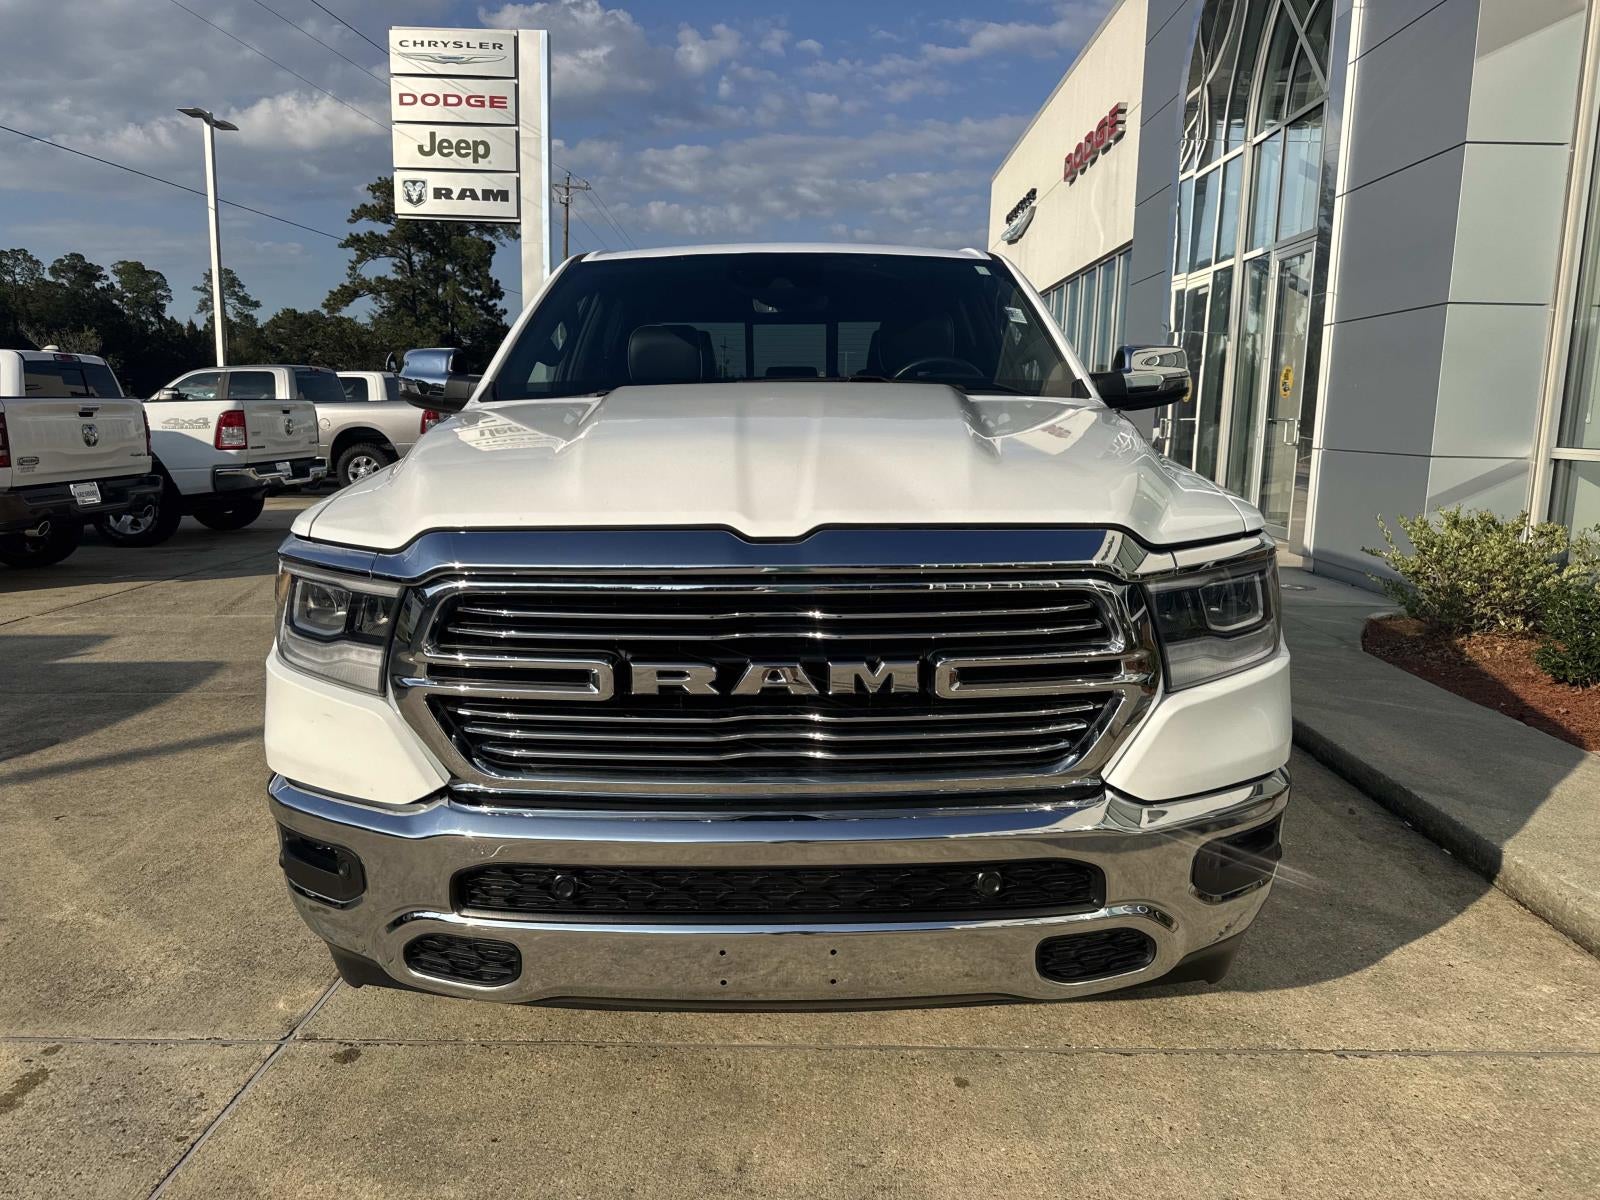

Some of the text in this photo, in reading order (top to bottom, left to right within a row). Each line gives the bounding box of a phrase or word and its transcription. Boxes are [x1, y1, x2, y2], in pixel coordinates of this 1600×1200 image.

[399, 39, 504, 50] CHRYSLER
[399, 93, 508, 109] DODGE
[417, 131, 491, 163] Jeep
[1064, 102, 1128, 182] DODGE
[433, 187, 509, 202] RAM
[631, 660, 920, 695] RAM
